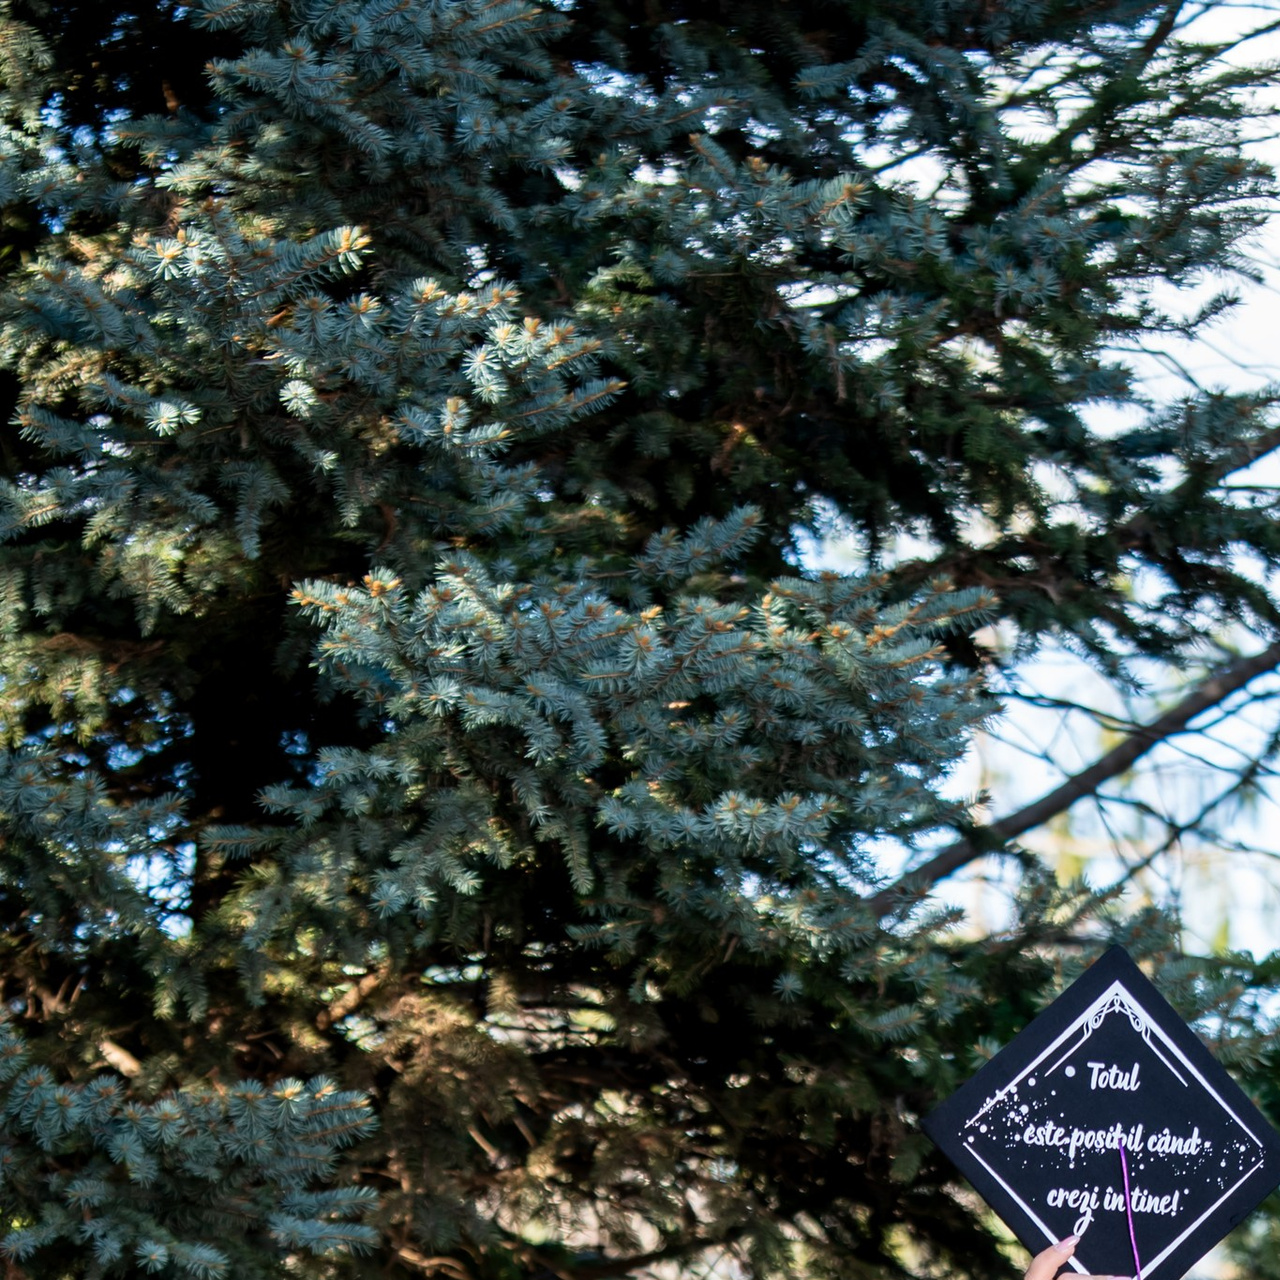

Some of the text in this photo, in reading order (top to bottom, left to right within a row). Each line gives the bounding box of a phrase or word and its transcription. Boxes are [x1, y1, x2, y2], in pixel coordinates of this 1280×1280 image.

[1087, 1061, 1141, 1092] Totul
[1023, 1120, 1202, 1159] este posibil când
[1047, 1185, 1180, 1237] crezi în tine!
